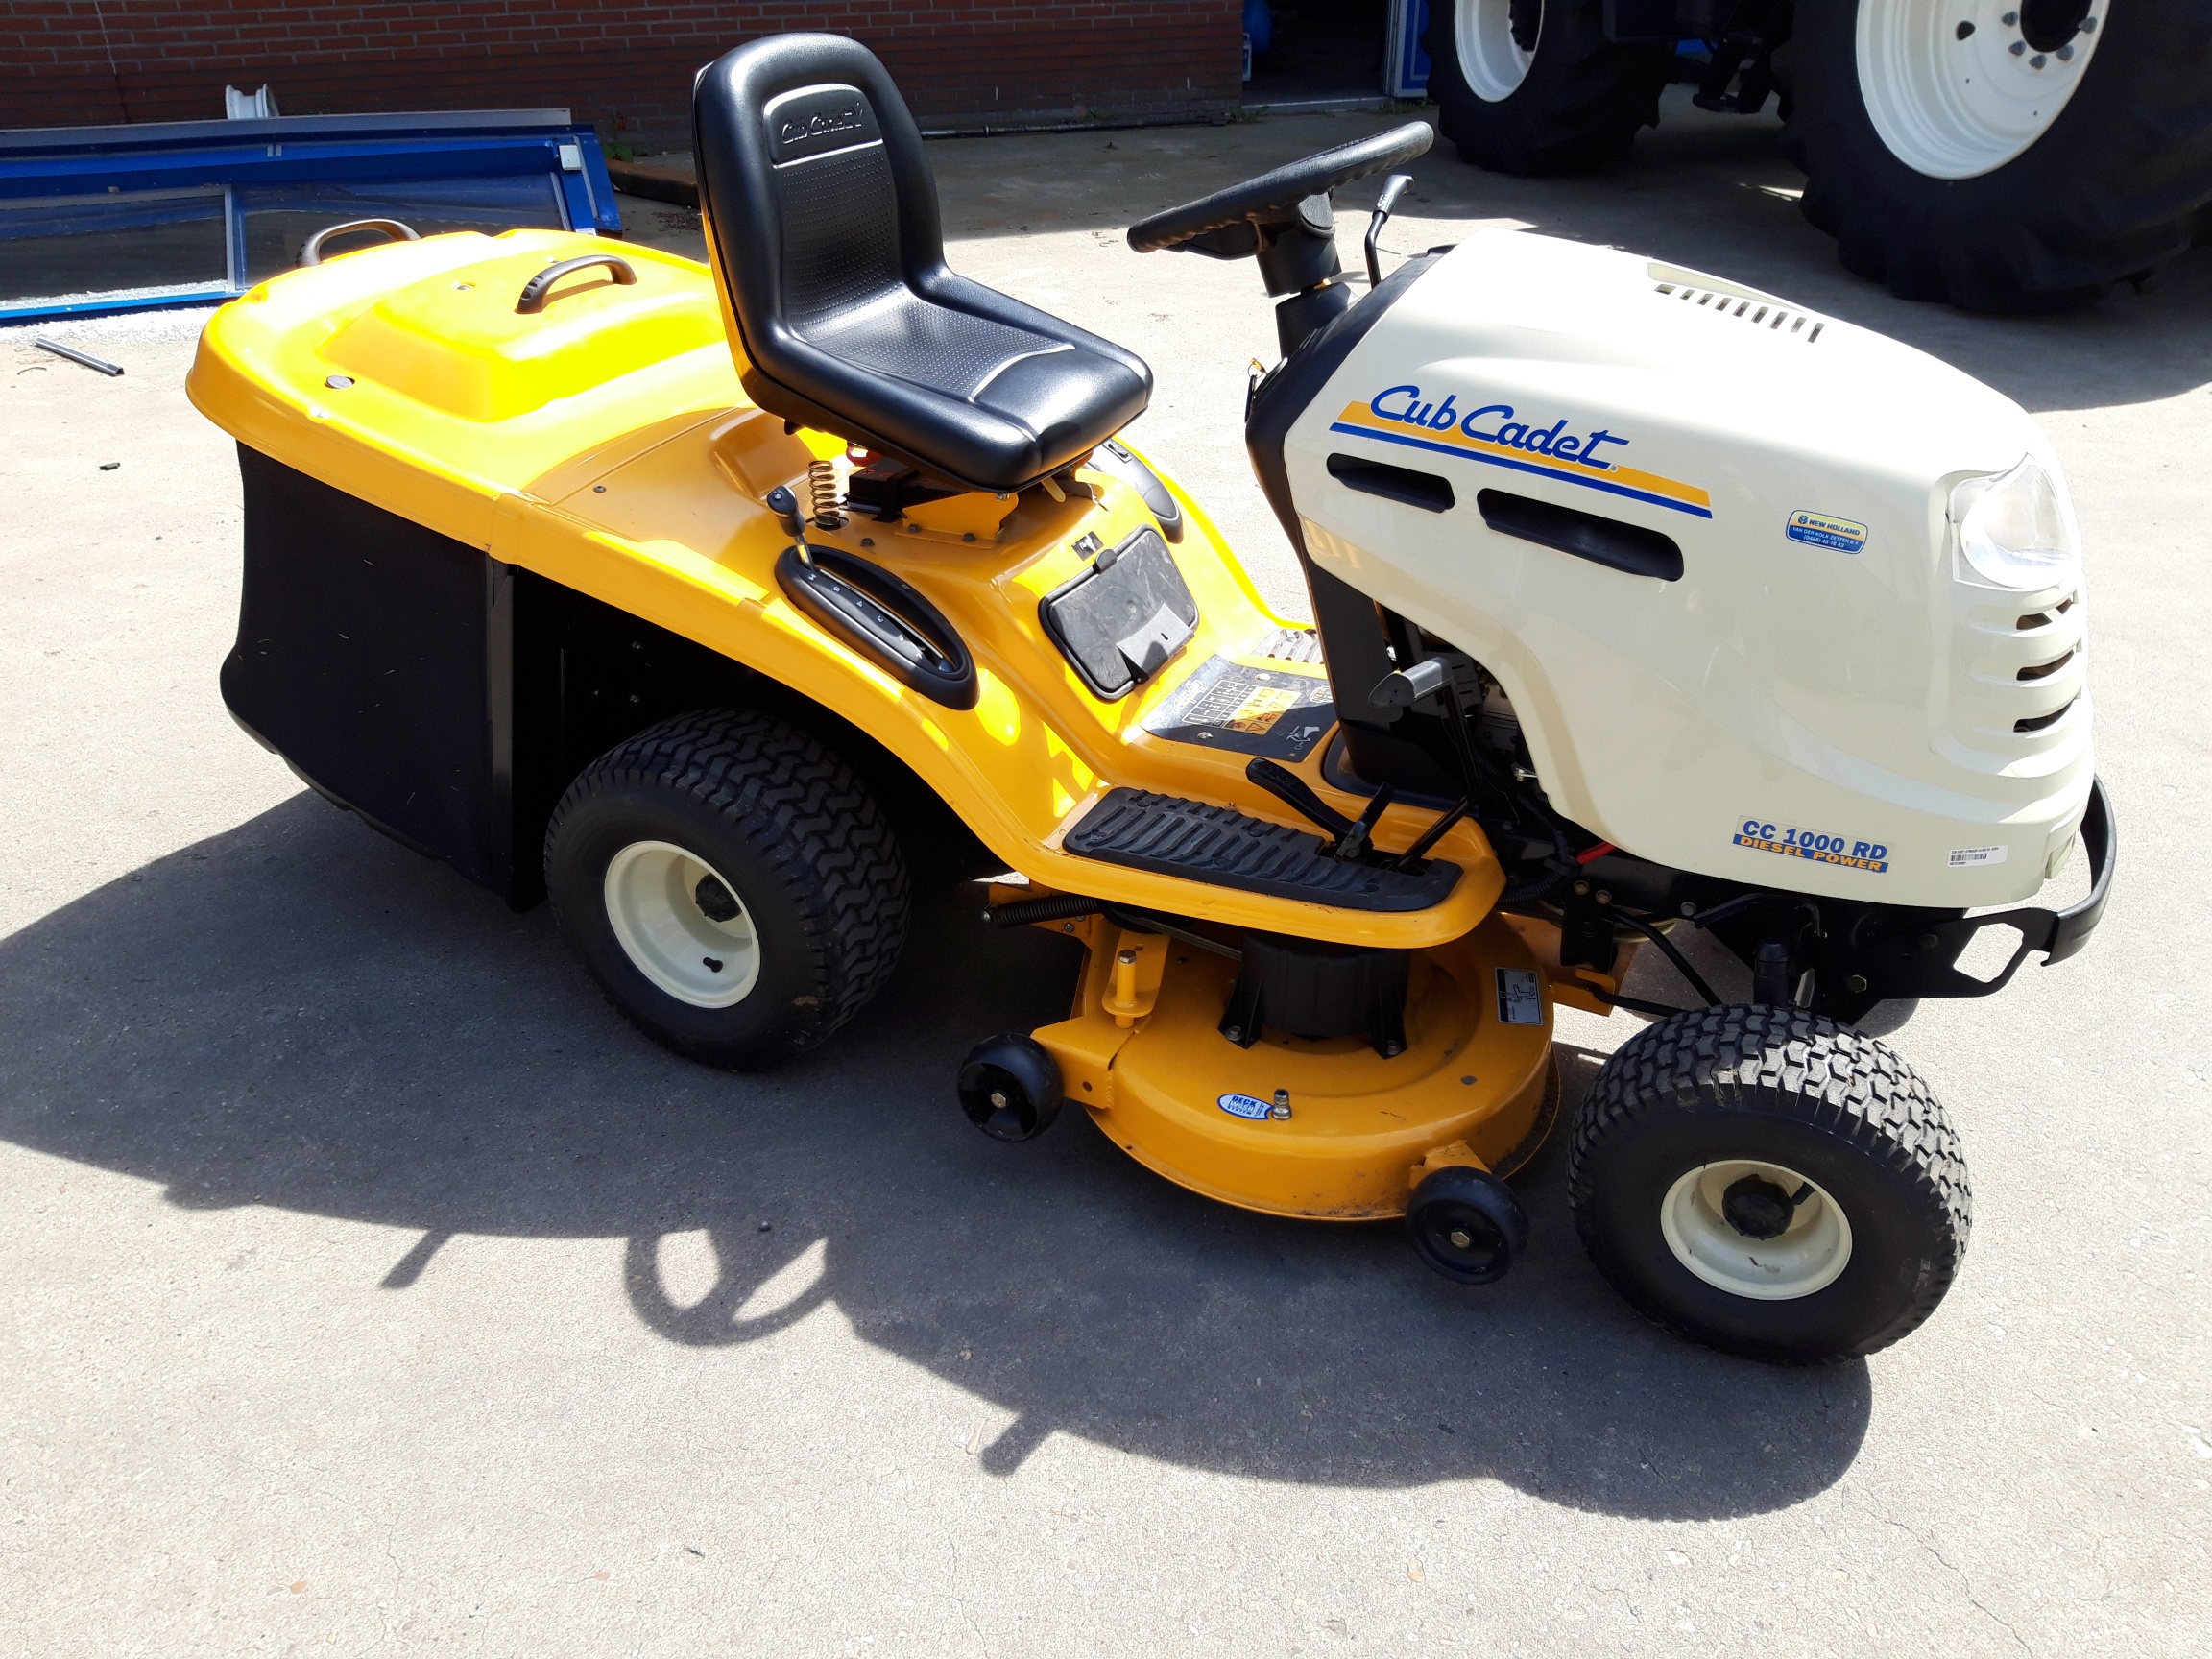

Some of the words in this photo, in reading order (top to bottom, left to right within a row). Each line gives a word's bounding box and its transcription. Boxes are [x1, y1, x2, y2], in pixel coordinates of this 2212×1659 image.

[1370, 385, 1457, 431] Cub
[1460, 404, 1630, 469] Cadet
[1810, 519, 1826, 528] NEW
[1827, 523, 1861, 536] HOLLAND
[1743, 820, 1776, 839] CC
[1783, 829, 1845, 854] 1000
[1851, 841, 1887, 860] RD
[1740, 836, 1805, 857] DIESEL
[1813, 851, 1883, 871] POWER
[1229, 1101, 1255, 1113] WASH
[1232, 1095, 1258, 1107] DECK
